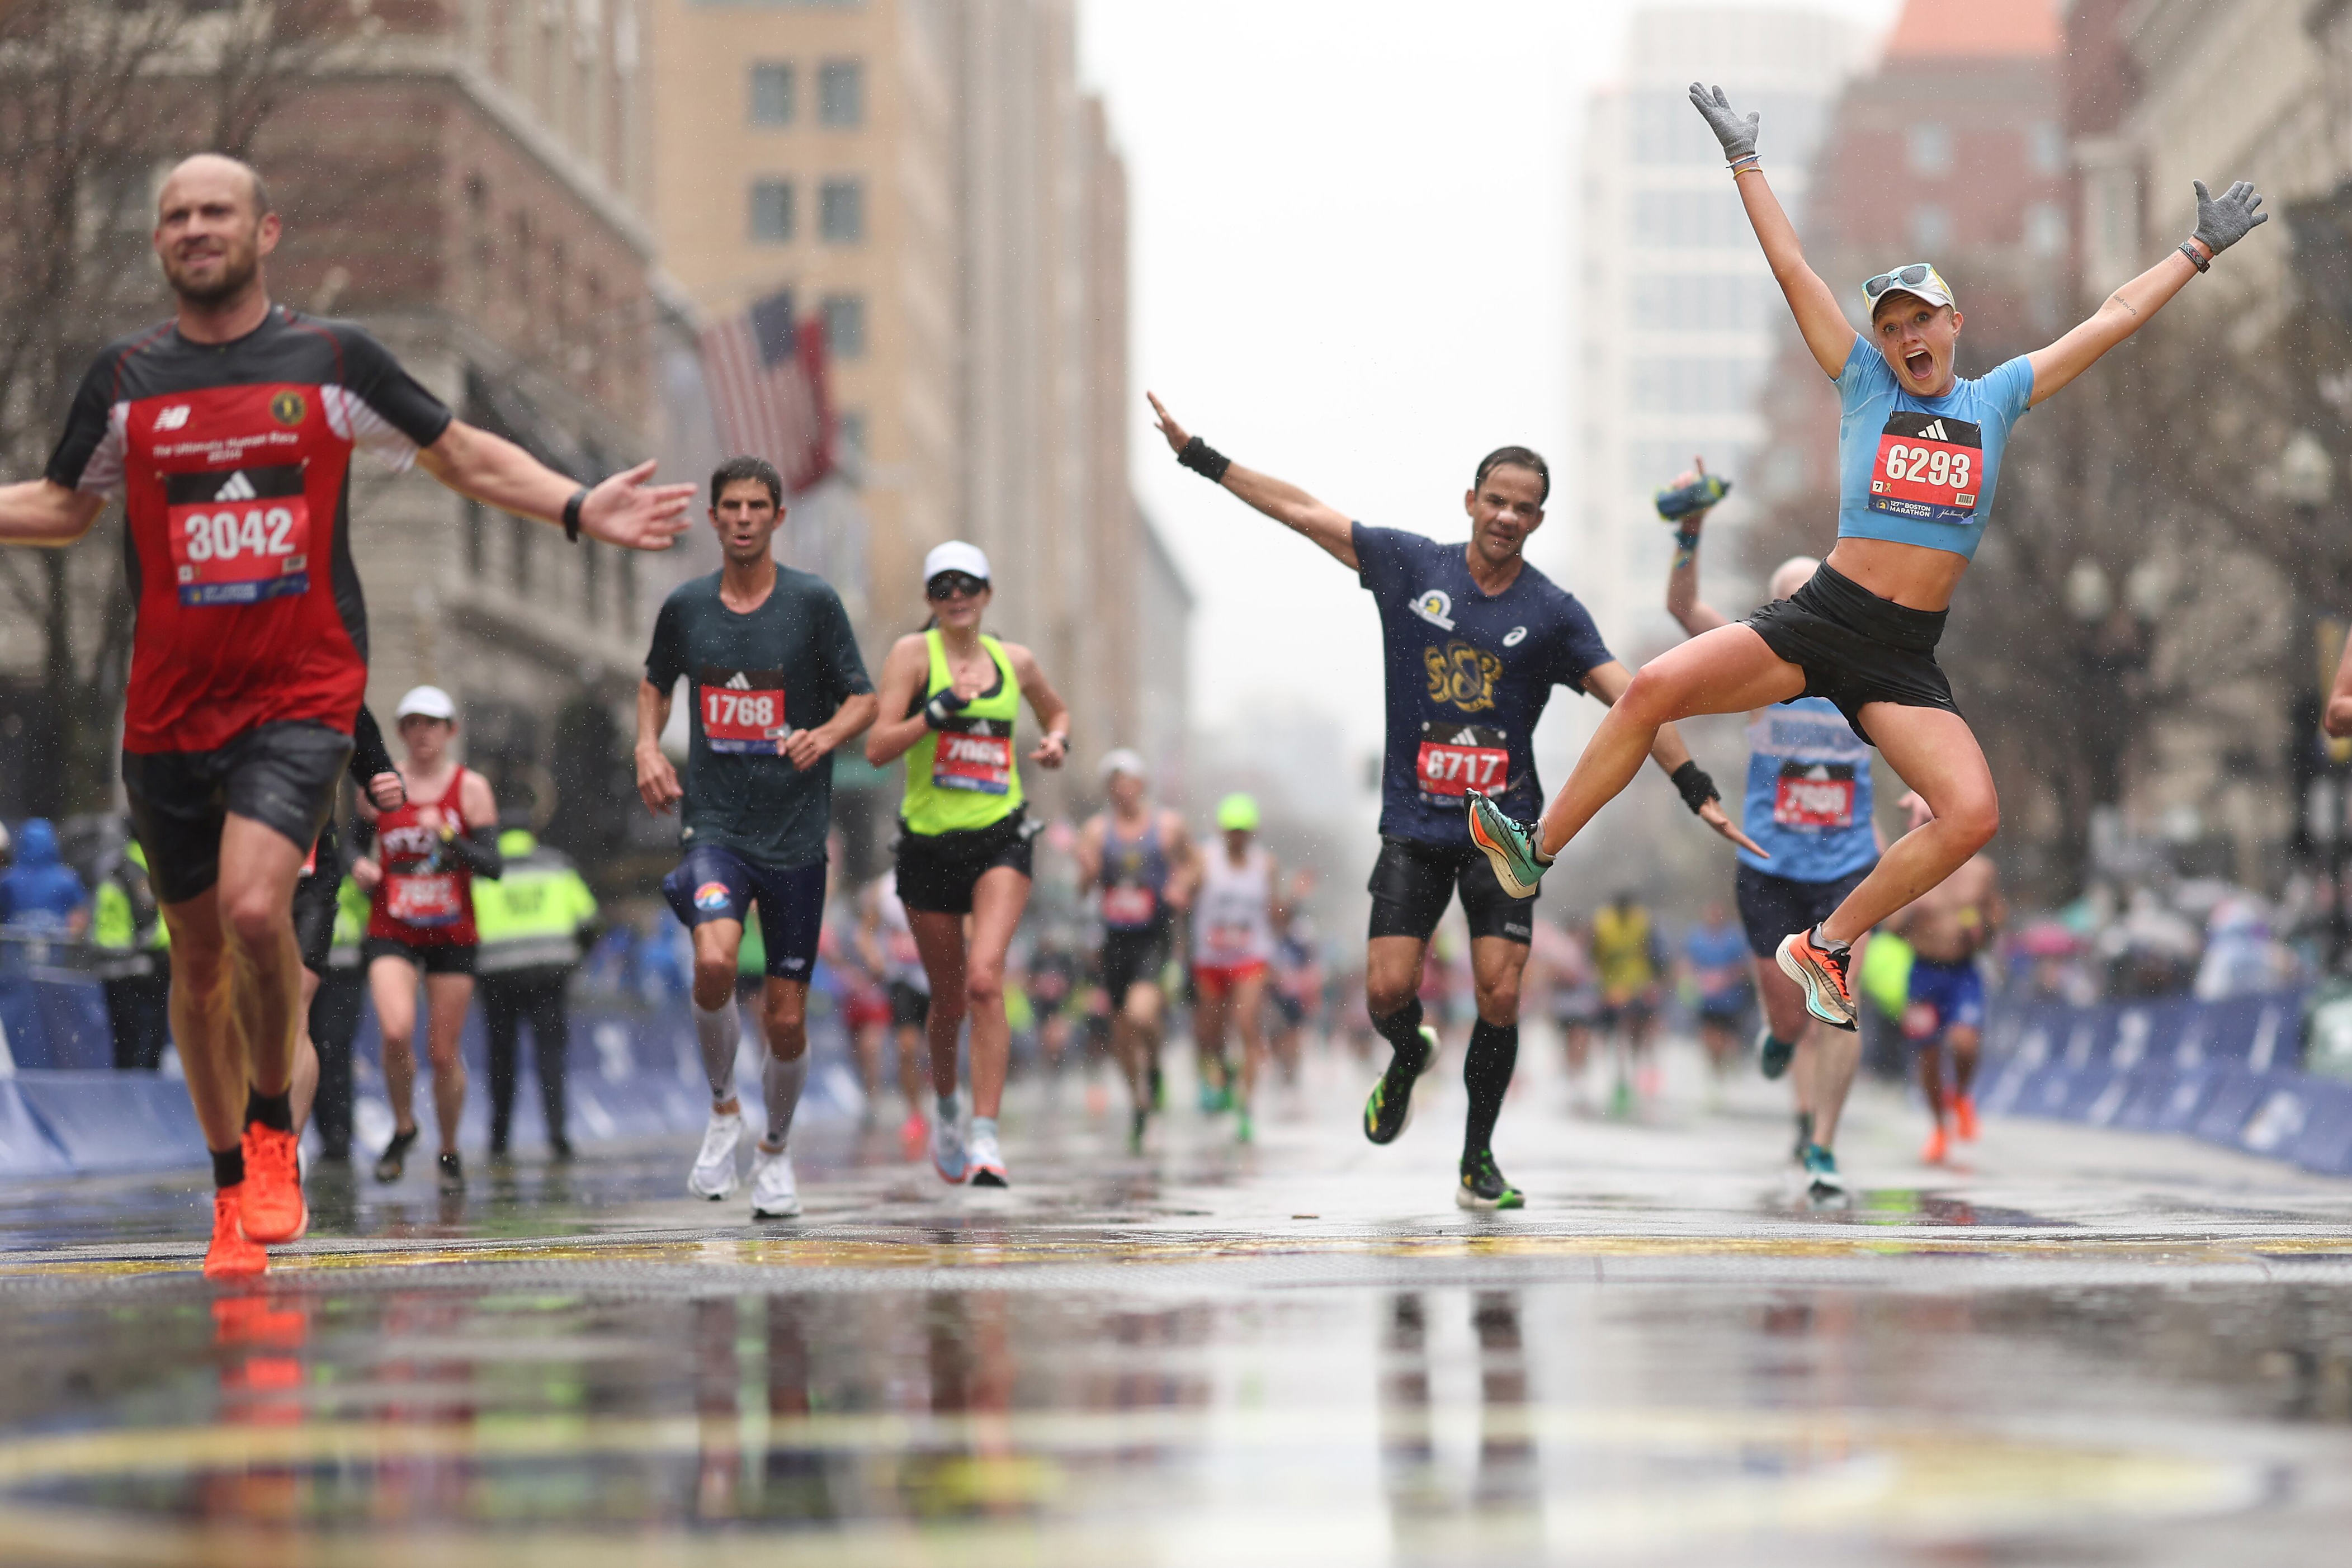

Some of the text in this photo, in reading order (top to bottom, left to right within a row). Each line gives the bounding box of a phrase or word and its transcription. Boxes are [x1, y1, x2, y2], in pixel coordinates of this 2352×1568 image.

[1886, 444, 1971, 489] 6293
[1890, 506, 1930, 517] MARATHON
[1905, 503, 1931, 512] BOSTON
[185, 507, 295, 563] 3042
[707, 694, 774, 726] 1768
[1427, 750, 1499, 783] 6717
